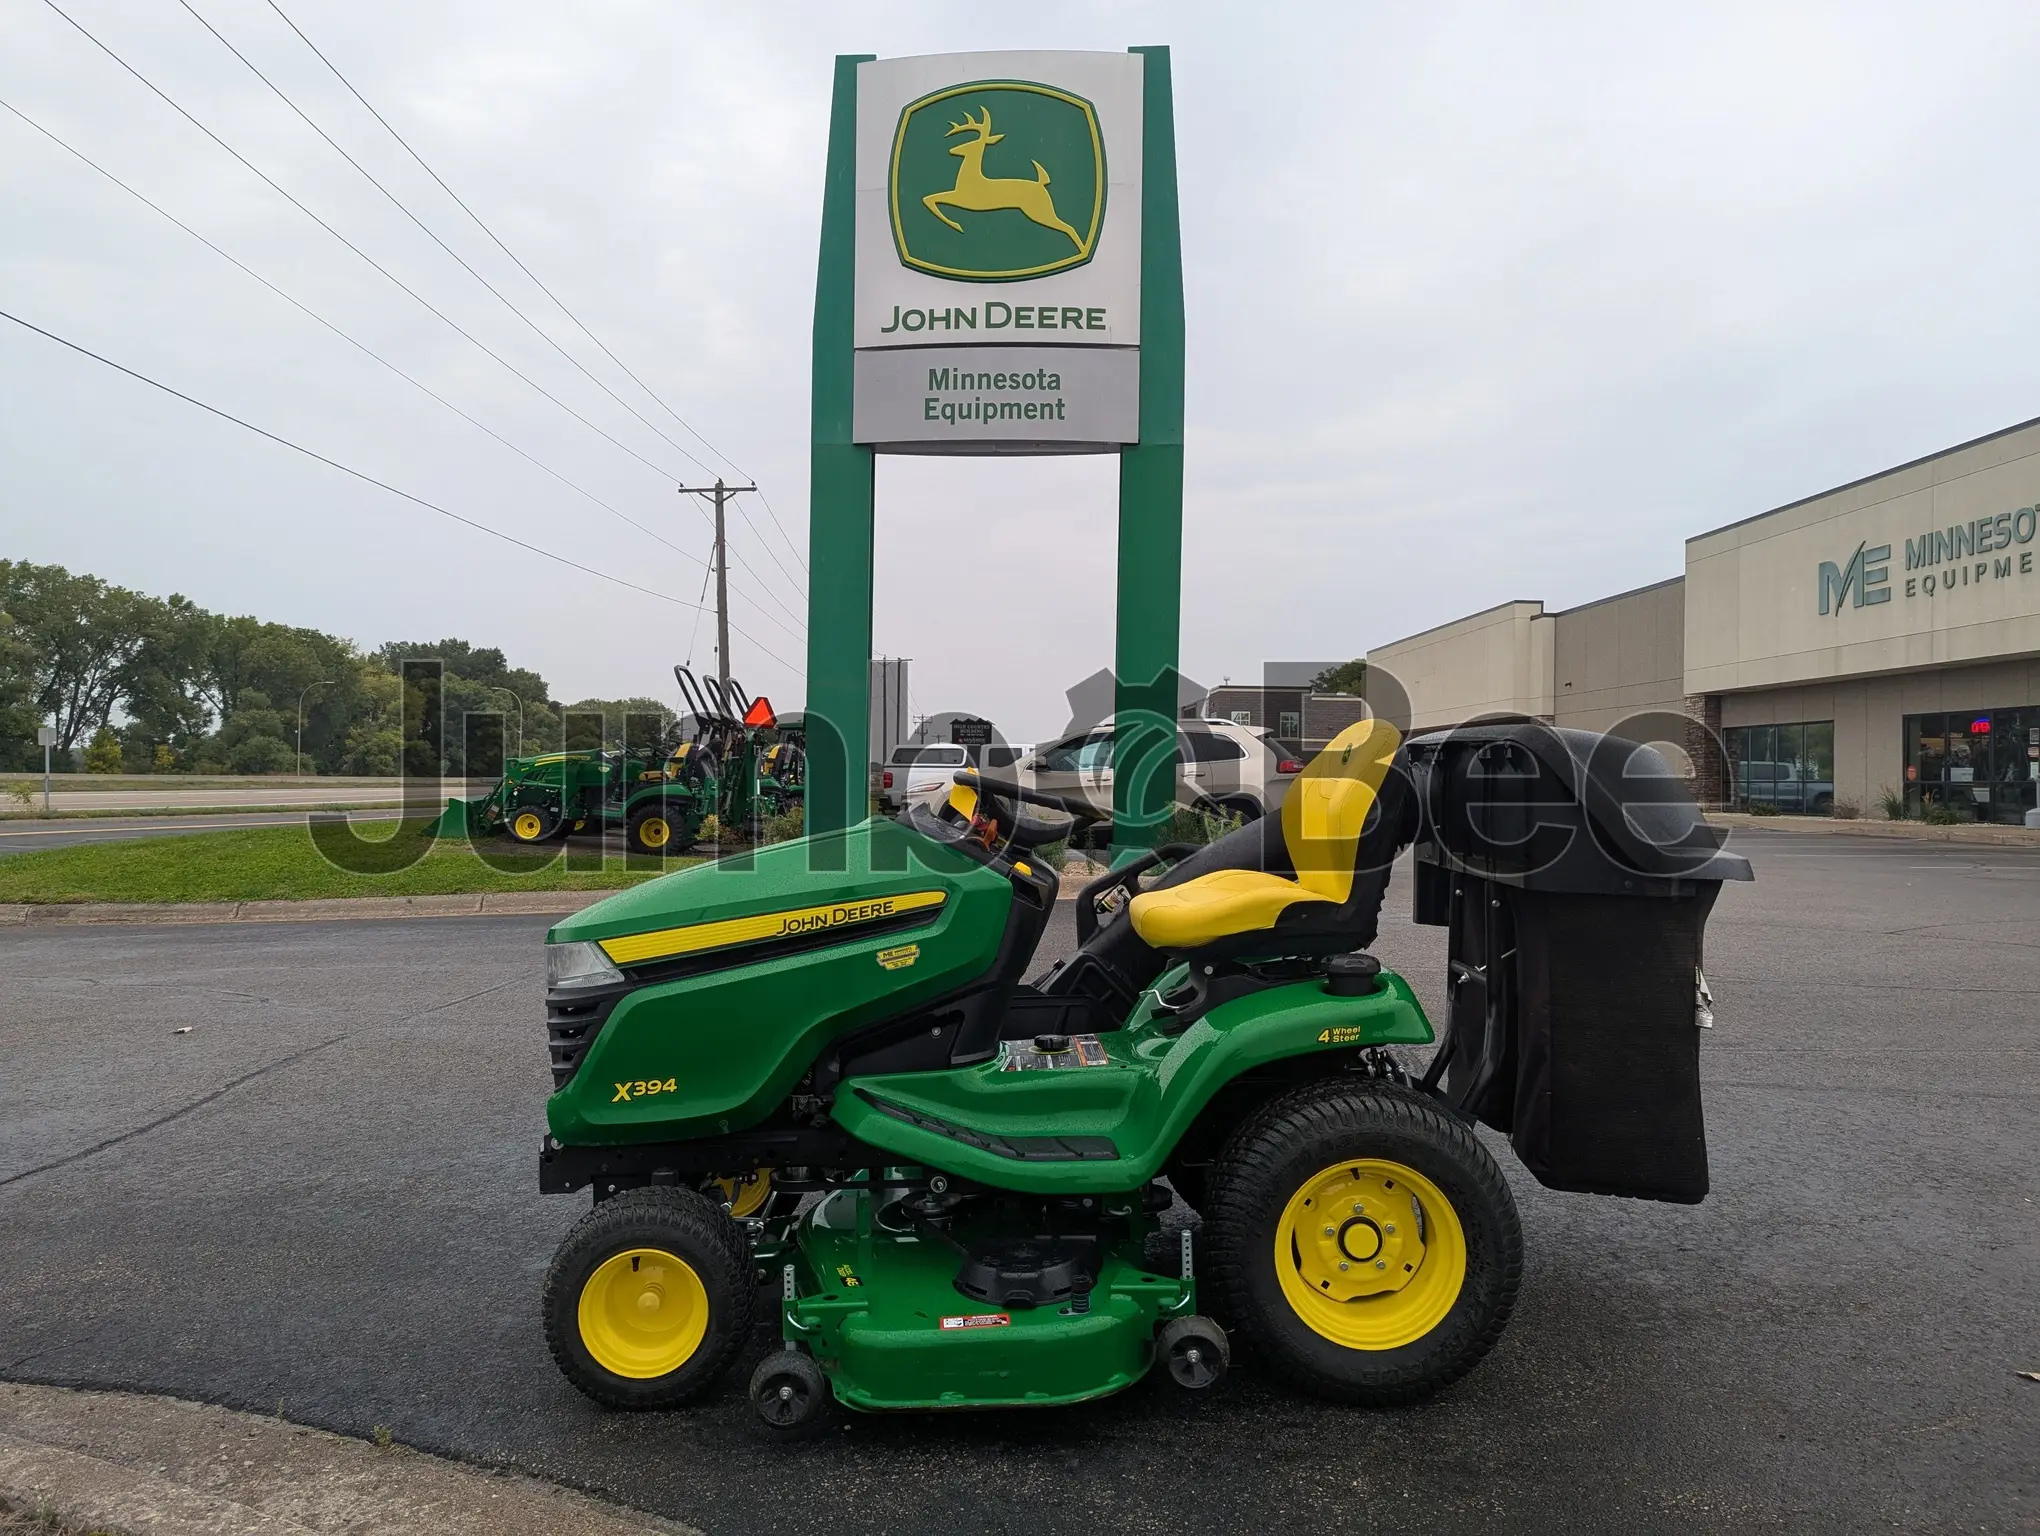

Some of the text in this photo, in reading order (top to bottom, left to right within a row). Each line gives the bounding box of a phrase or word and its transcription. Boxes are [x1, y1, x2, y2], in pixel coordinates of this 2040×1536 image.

[881, 301, 1107, 333] JOHN DEERE
[928, 367, 1061, 391] Minnesota
[924, 396, 1066, 425] Equipment
[1905, 503, 2040, 571] MINNESO
[1905, 551, 2033, 598] EQUIPME
[776, 901, 894, 936] JOHN DEERE
[1317, 1025, 1361, 1044] 4 Wheel
[1332, 1034, 1360, 1043] Steer
[610, 1077, 678, 1104] X394
